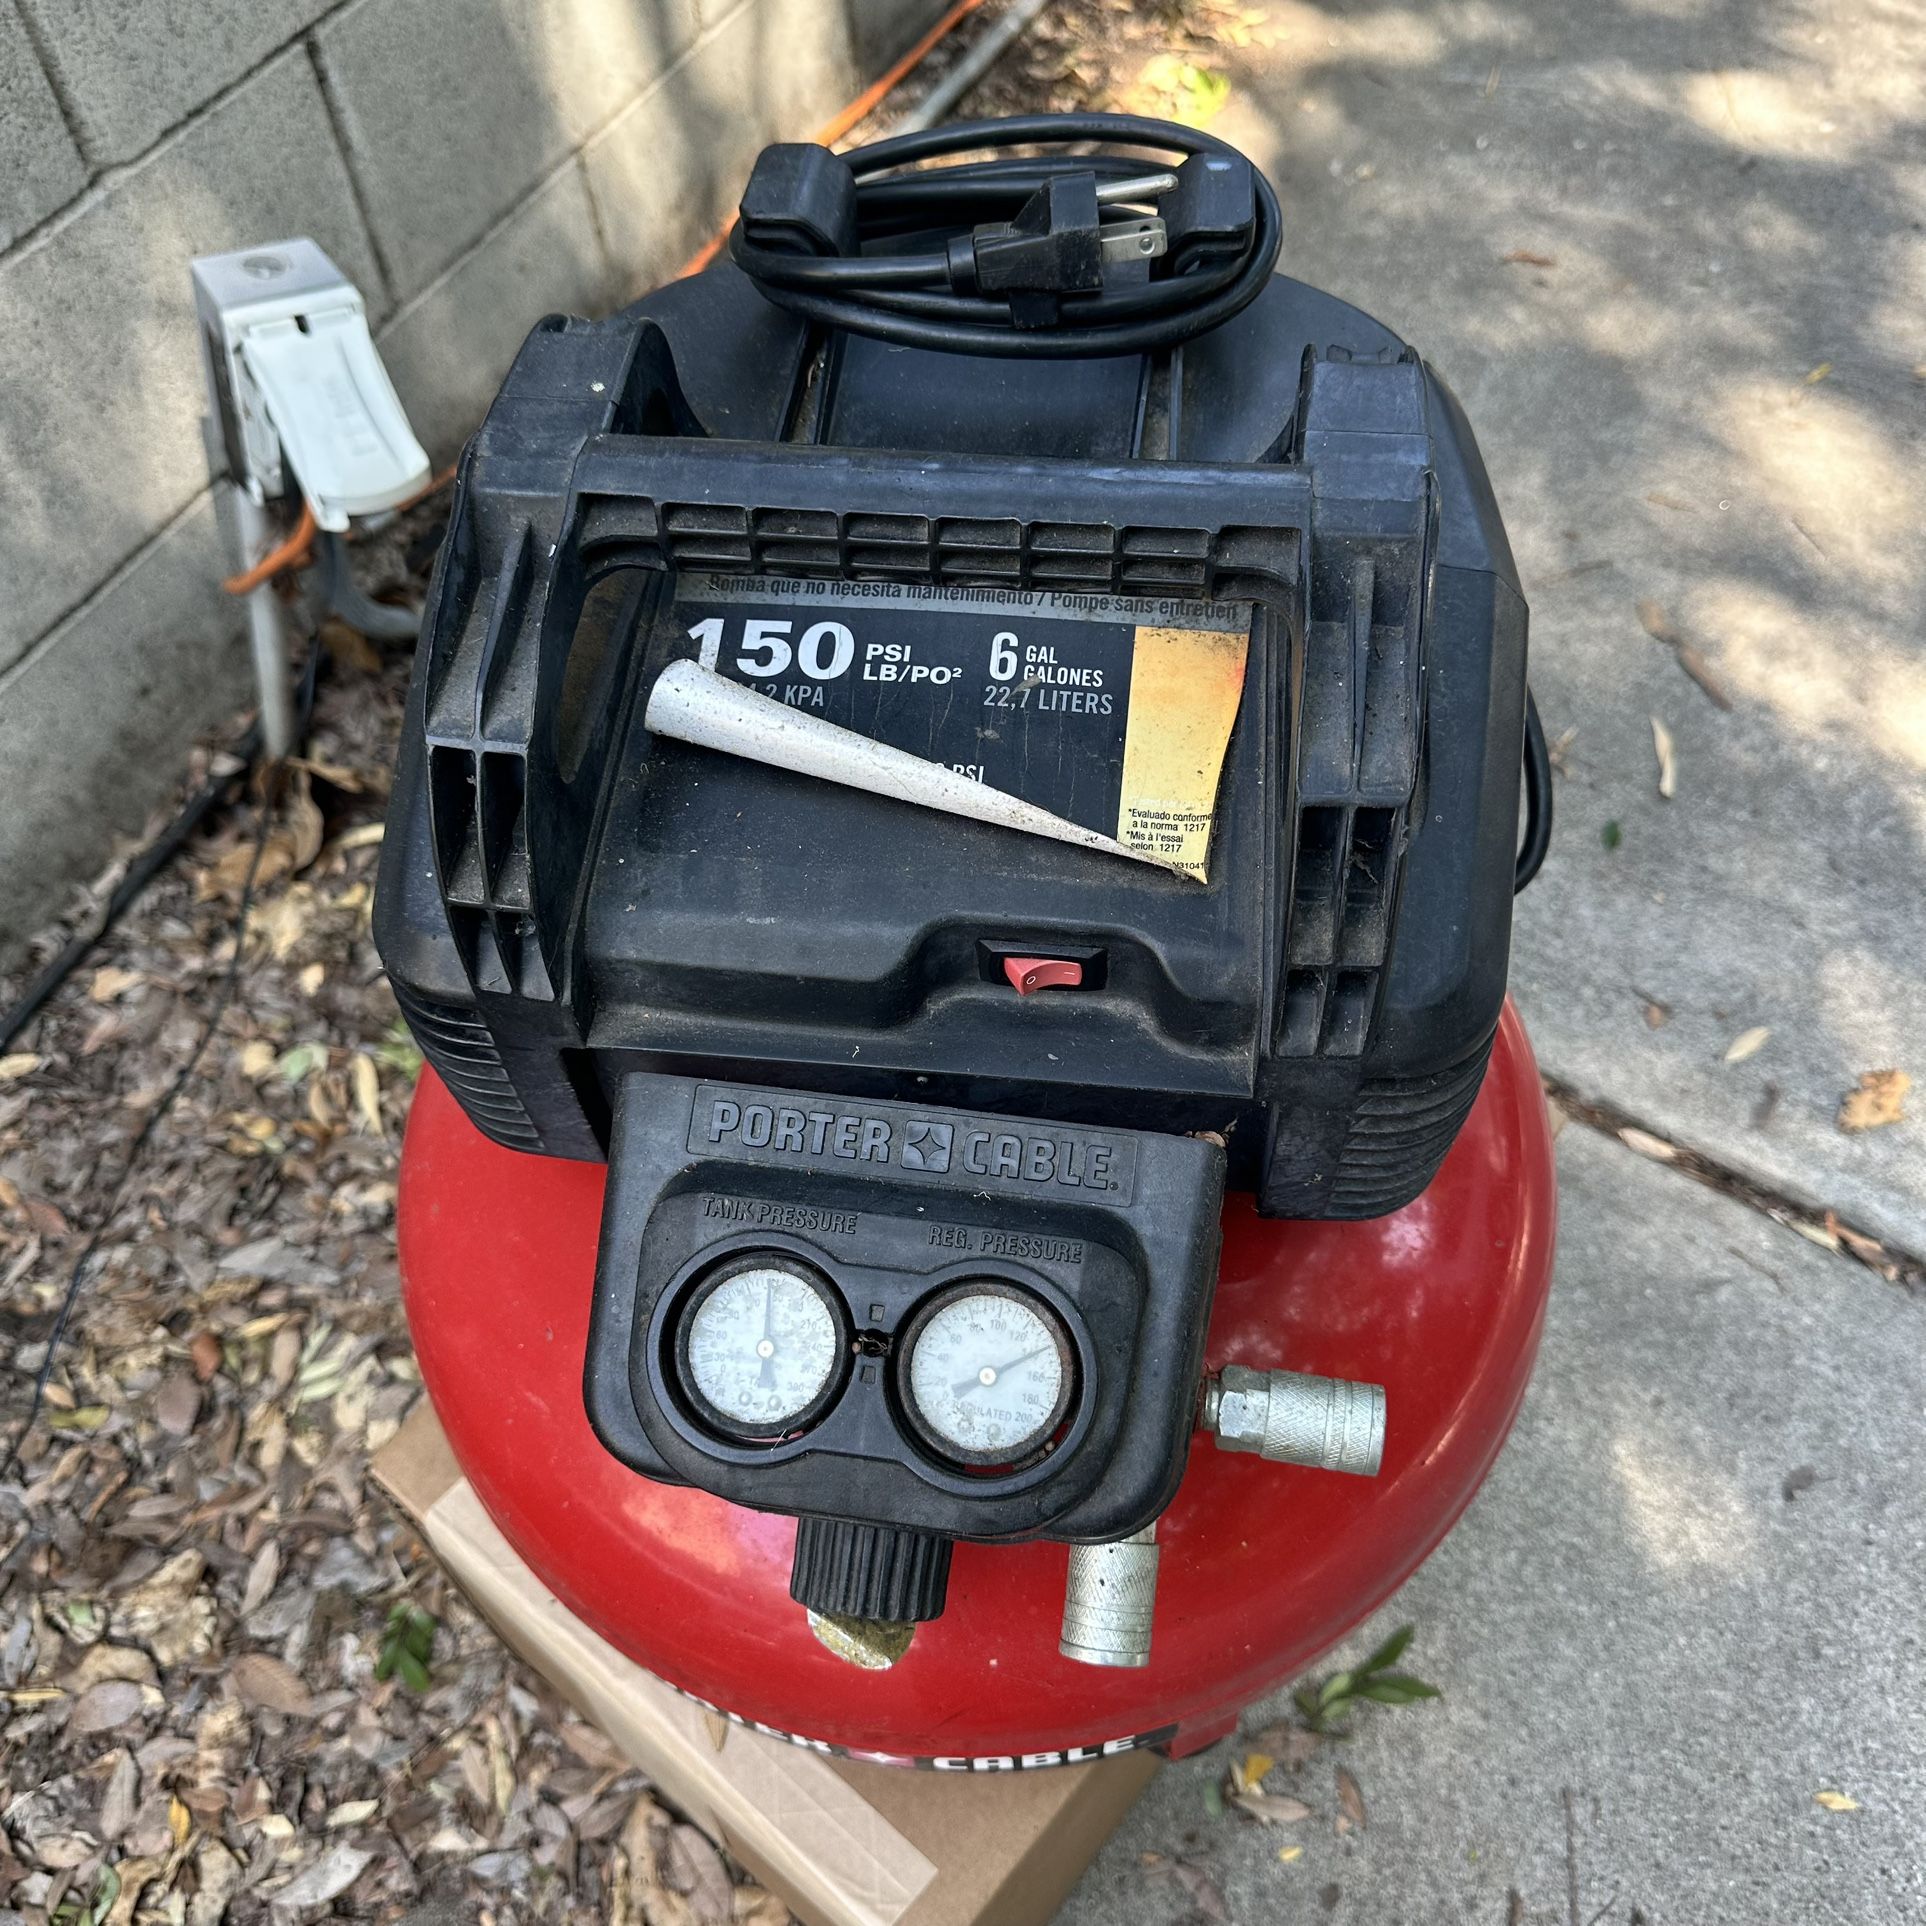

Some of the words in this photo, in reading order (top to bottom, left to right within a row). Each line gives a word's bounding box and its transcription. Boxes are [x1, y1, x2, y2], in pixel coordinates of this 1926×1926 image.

[771, 579, 800, 596] que
[805, 580, 826, 595] no
[830, 580, 901, 598] necesita
[906, 585, 1034, 605] mantenimiento
[1050, 593, 1110, 611] Pompe
[1114, 597, 1154, 614] sans
[1159, 600, 1237, 619] entretien
[687, 617, 855, 680] 150
[866, 643, 911, 662] PSI
[989, 631, 1019, 681] 6
[1025, 645, 1058, 664] GAL
[1023, 665, 1103, 688] GALONES
[784, 684, 824, 707] KPA
[984, 685, 1032, 711] 22,7
[1038, 688, 1114, 715] LITERS
[1132, 820, 1138, 828] a
[1141, 820, 1148, 829] la
[1151, 822, 1178, 831] norma
[1184, 823, 1206, 832] 1217
[1172, 813, 1213, 823] conforme
[1130, 842, 1154, 851] selon
[1160, 843, 1182, 852] 1217
[1148, 832, 1154, 841] à
[1156, 833, 1184, 843] l'essai
[708, 1100, 893, 1164] PORTER
[962, 1130, 1113, 1189] CABLE
[703, 1197, 754, 1220] TANK
[757, 1203, 858, 1235] PRESSURE
[929, 1224, 973, 1250] REG.
[980, 1231, 1083, 1264] PRESSURE
[932, 1735, 1136, 1771] CABLE
